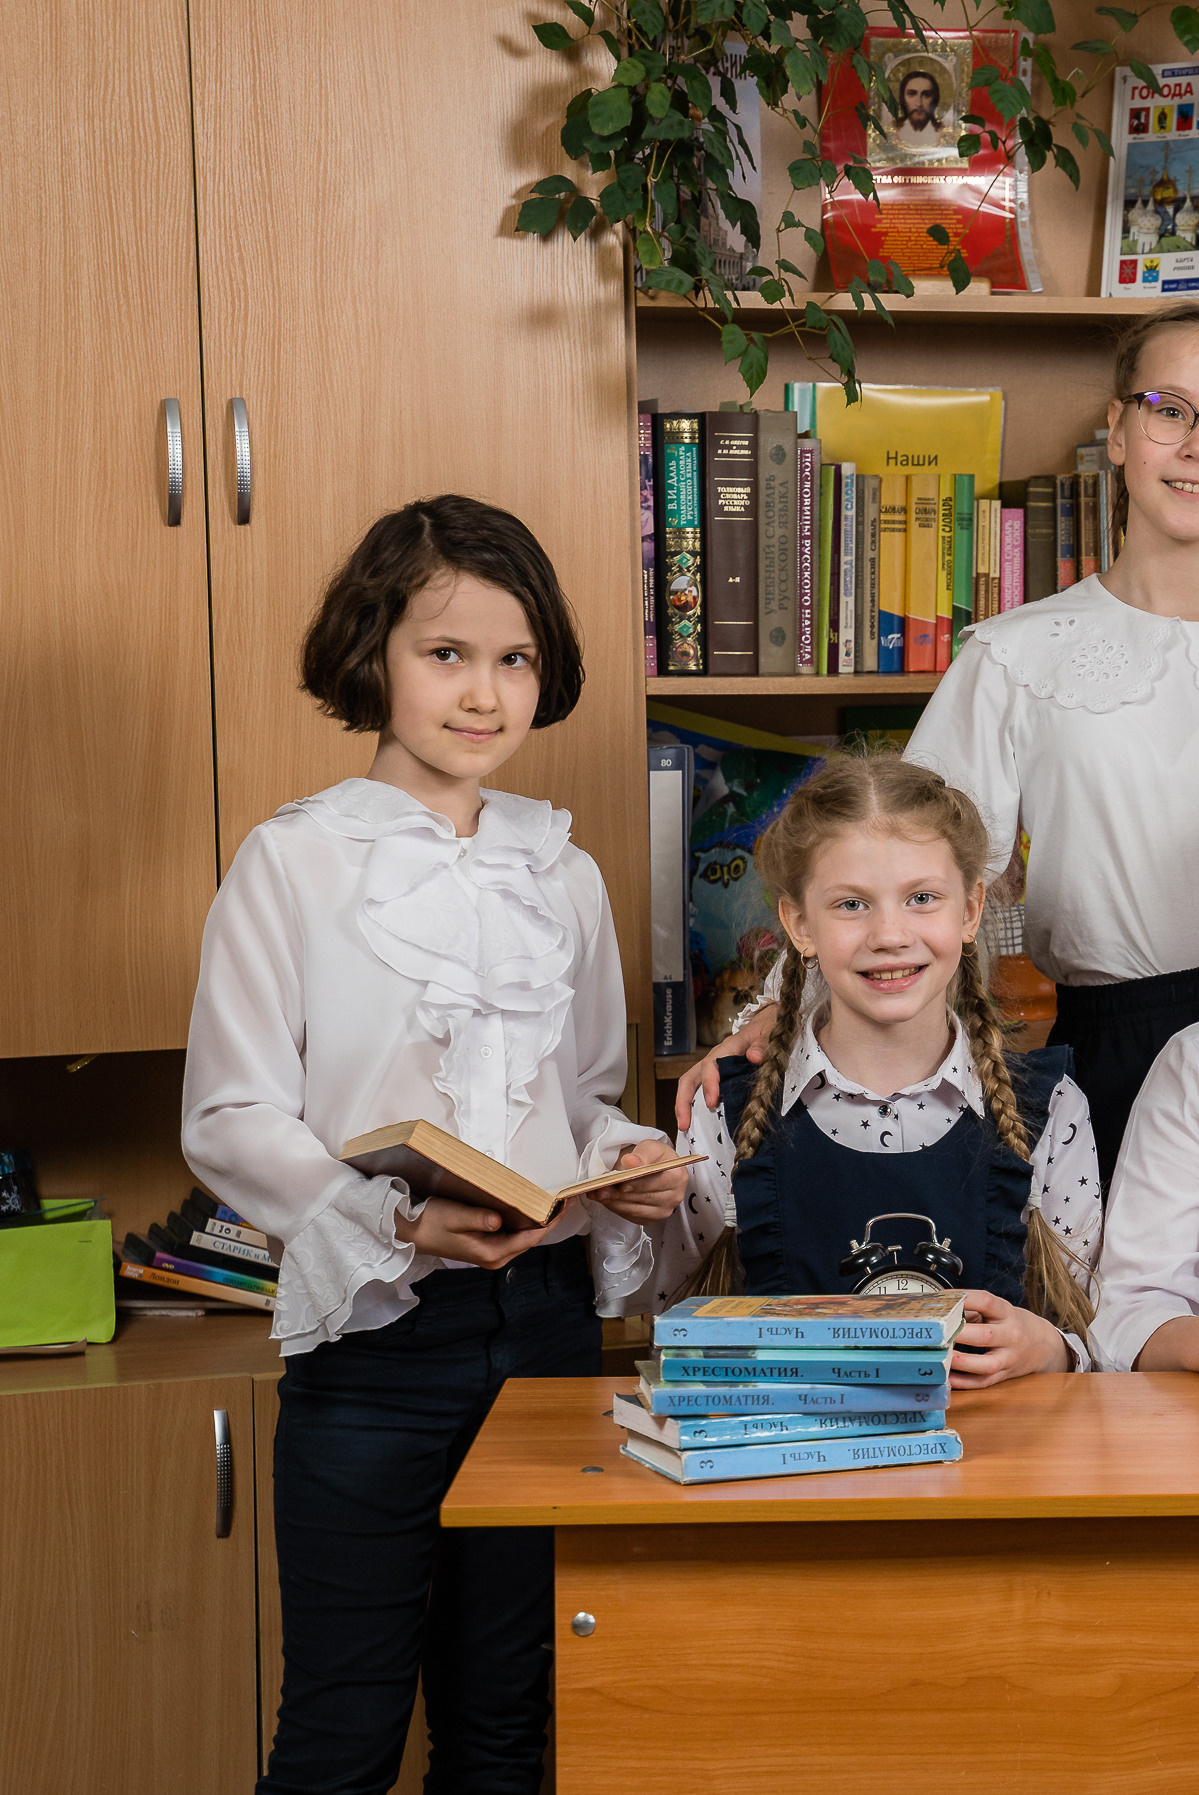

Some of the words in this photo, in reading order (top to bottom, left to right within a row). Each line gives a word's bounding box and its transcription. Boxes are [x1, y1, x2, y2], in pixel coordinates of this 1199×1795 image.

[1131, 82, 1194, 100] ГООДА
[886, 450, 938, 467] Наши
[799, 452, 812, 536] ПОСЛОВИЦЫ
[844, 473, 854, 512] СЛОВА
[679, 481, 687, 525] ТОЛКОВЫЙ
[764, 474, 776, 539] СЛОВАРЬ
[778, 480, 789, 529] ЯЗЫКА
[880, 505, 907, 514] СЛОВАРЬ
[914, 506, 937, 516] СЛОВАРЬ
[941, 496, 953, 533] СЛОВАРЬ
[869, 517, 877, 552] СЛОВАРЬ
[1004, 519, 1013, 560] СЛОВАРЬ
[1012, 520, 1020, 545] СЛОВ
[763, 544, 777, 615] УЧЕБНЫЙ
[778, 534, 790, 611] РУССКОГО
[801, 540, 812, 606] РУССКОГО
[800, 609, 812, 661] НАРОДА
[661, 758, 672, 767] 80
[663, 987, 673, 1046] ErichKrause
[213, 1240, 252, 1258] СТАРИК
[148, 1271, 180, 1285] Лондон
[896, 1278, 909, 1291] 12
[672, 1328, 688, 1338] 3
[827, 1326, 933, 1340] ХРЕСТОМАТИЯ.
[680, 1366, 804, 1378] ХРЕСТОМАТИЯ.
[917, 1367, 933, 1377] 3
[667, 1394, 775, 1406] ХРЕСТОМАТИЯ.
[914, 1393, 930, 1403] 3
[693, 1429, 708, 1439] 3
[847, 1442, 948, 1461] ХРЕСТОМАТИЯ.
[699, 1460, 715, 1471] 3
